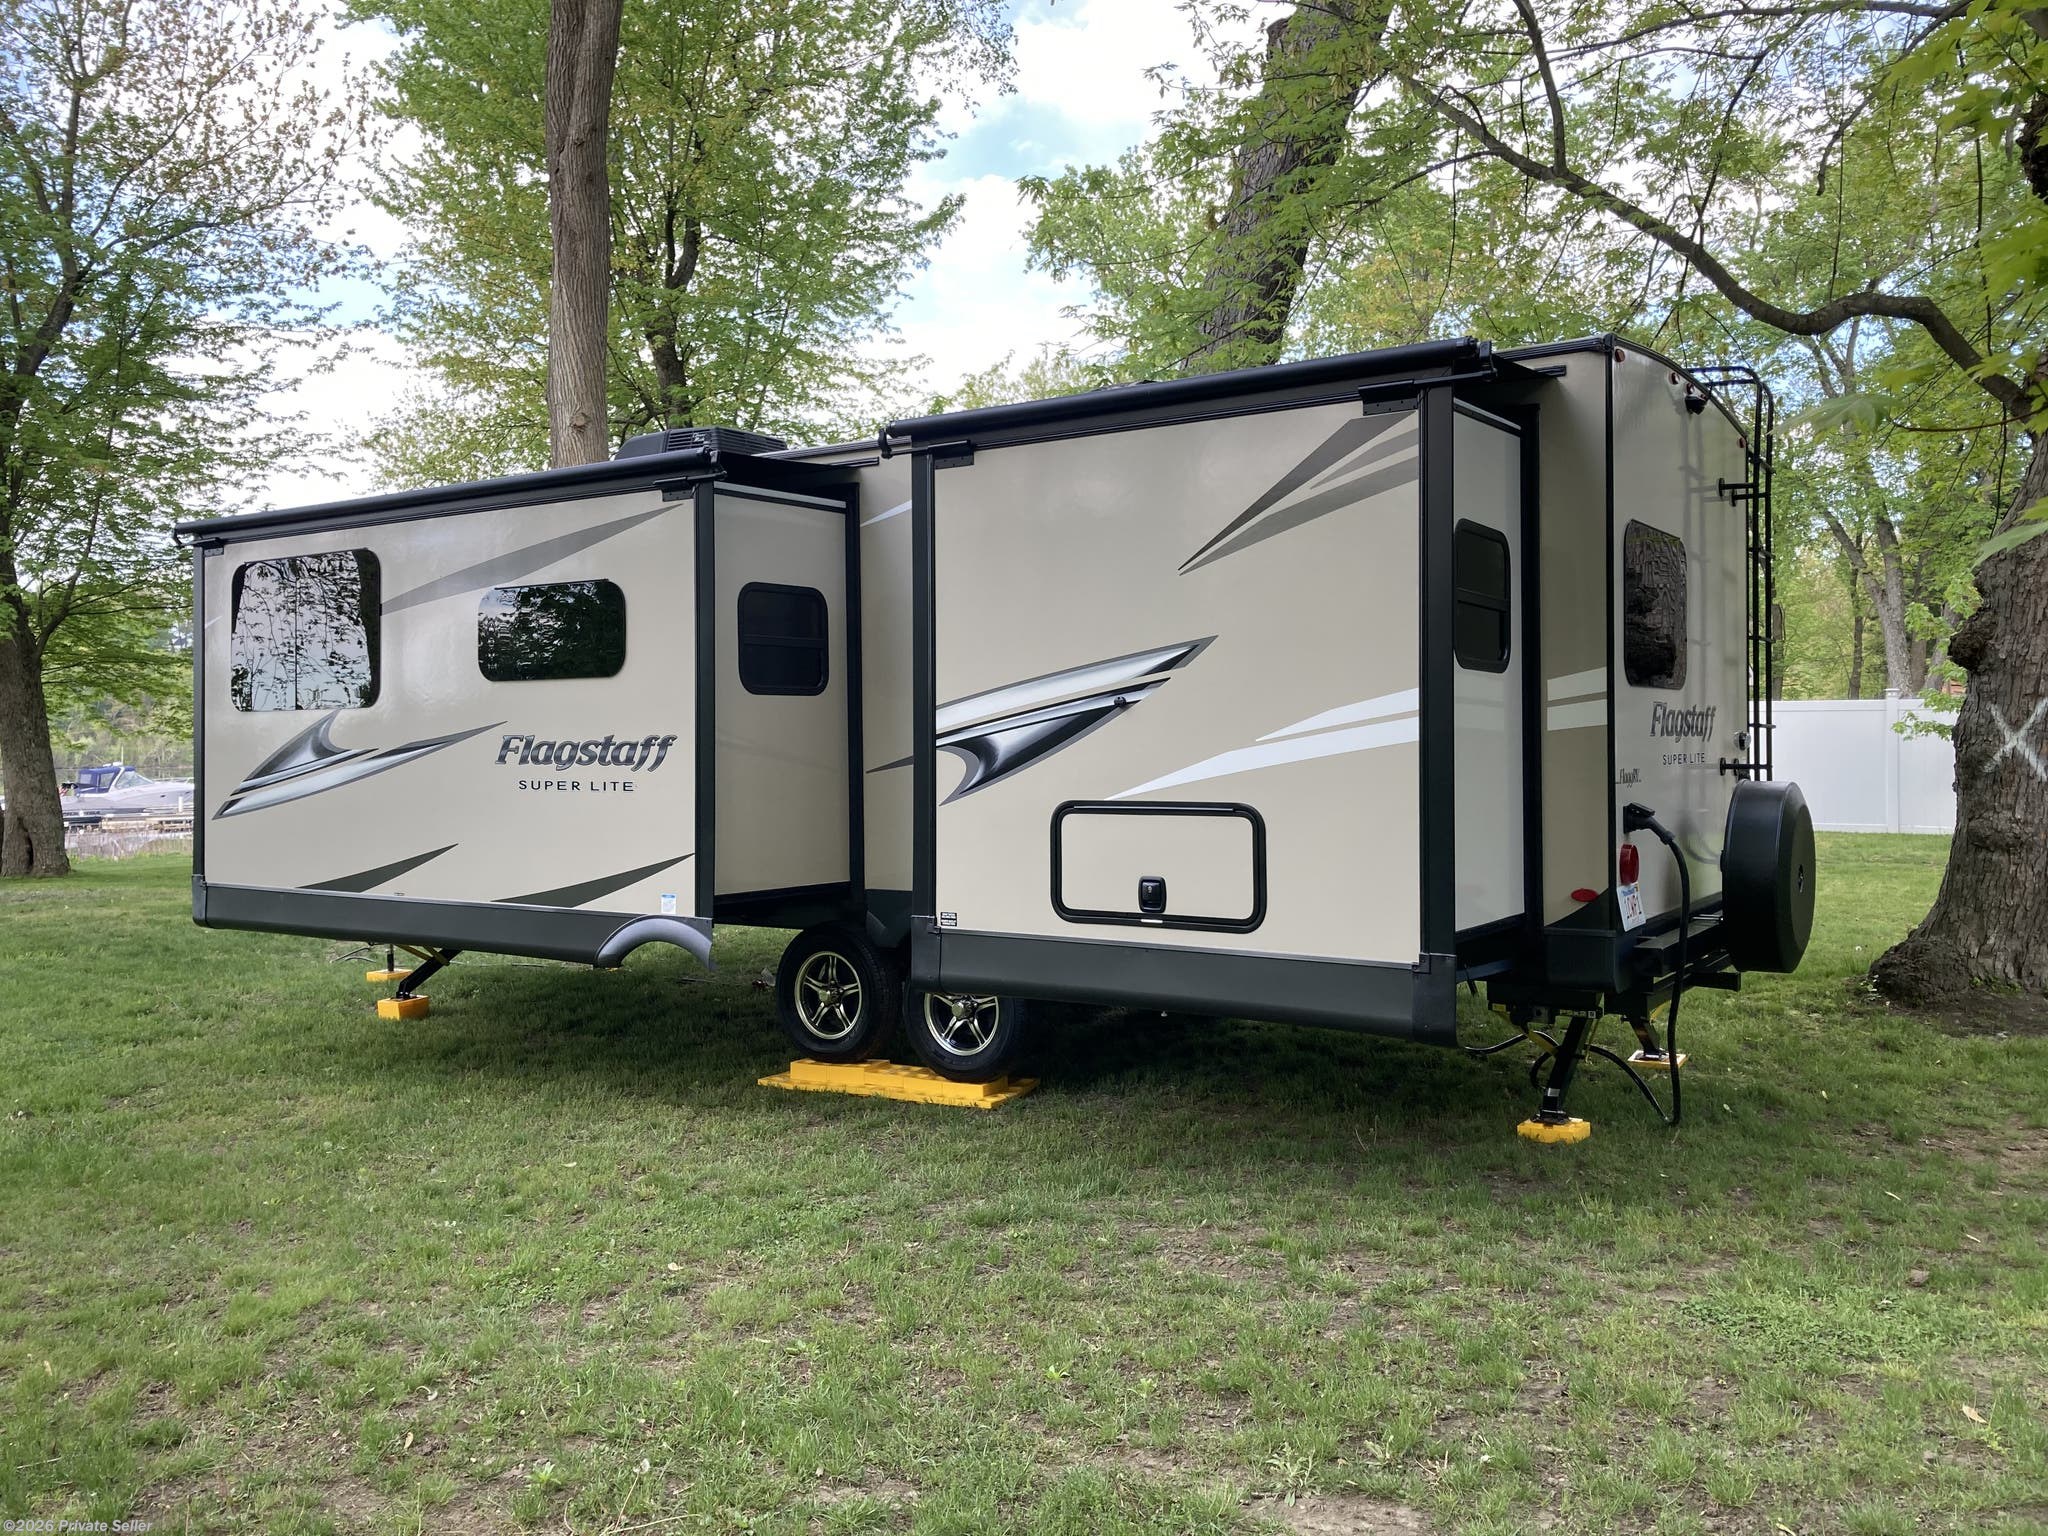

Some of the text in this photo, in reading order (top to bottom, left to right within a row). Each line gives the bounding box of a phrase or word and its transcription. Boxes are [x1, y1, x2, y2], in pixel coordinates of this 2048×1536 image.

[1649, 701, 1717, 743] Flagstaff
[495, 734, 678, 772] Flagstaff
[1662, 752, 1705, 766] SUPER LITE
[518, 780, 634, 792] SUPER LITE
